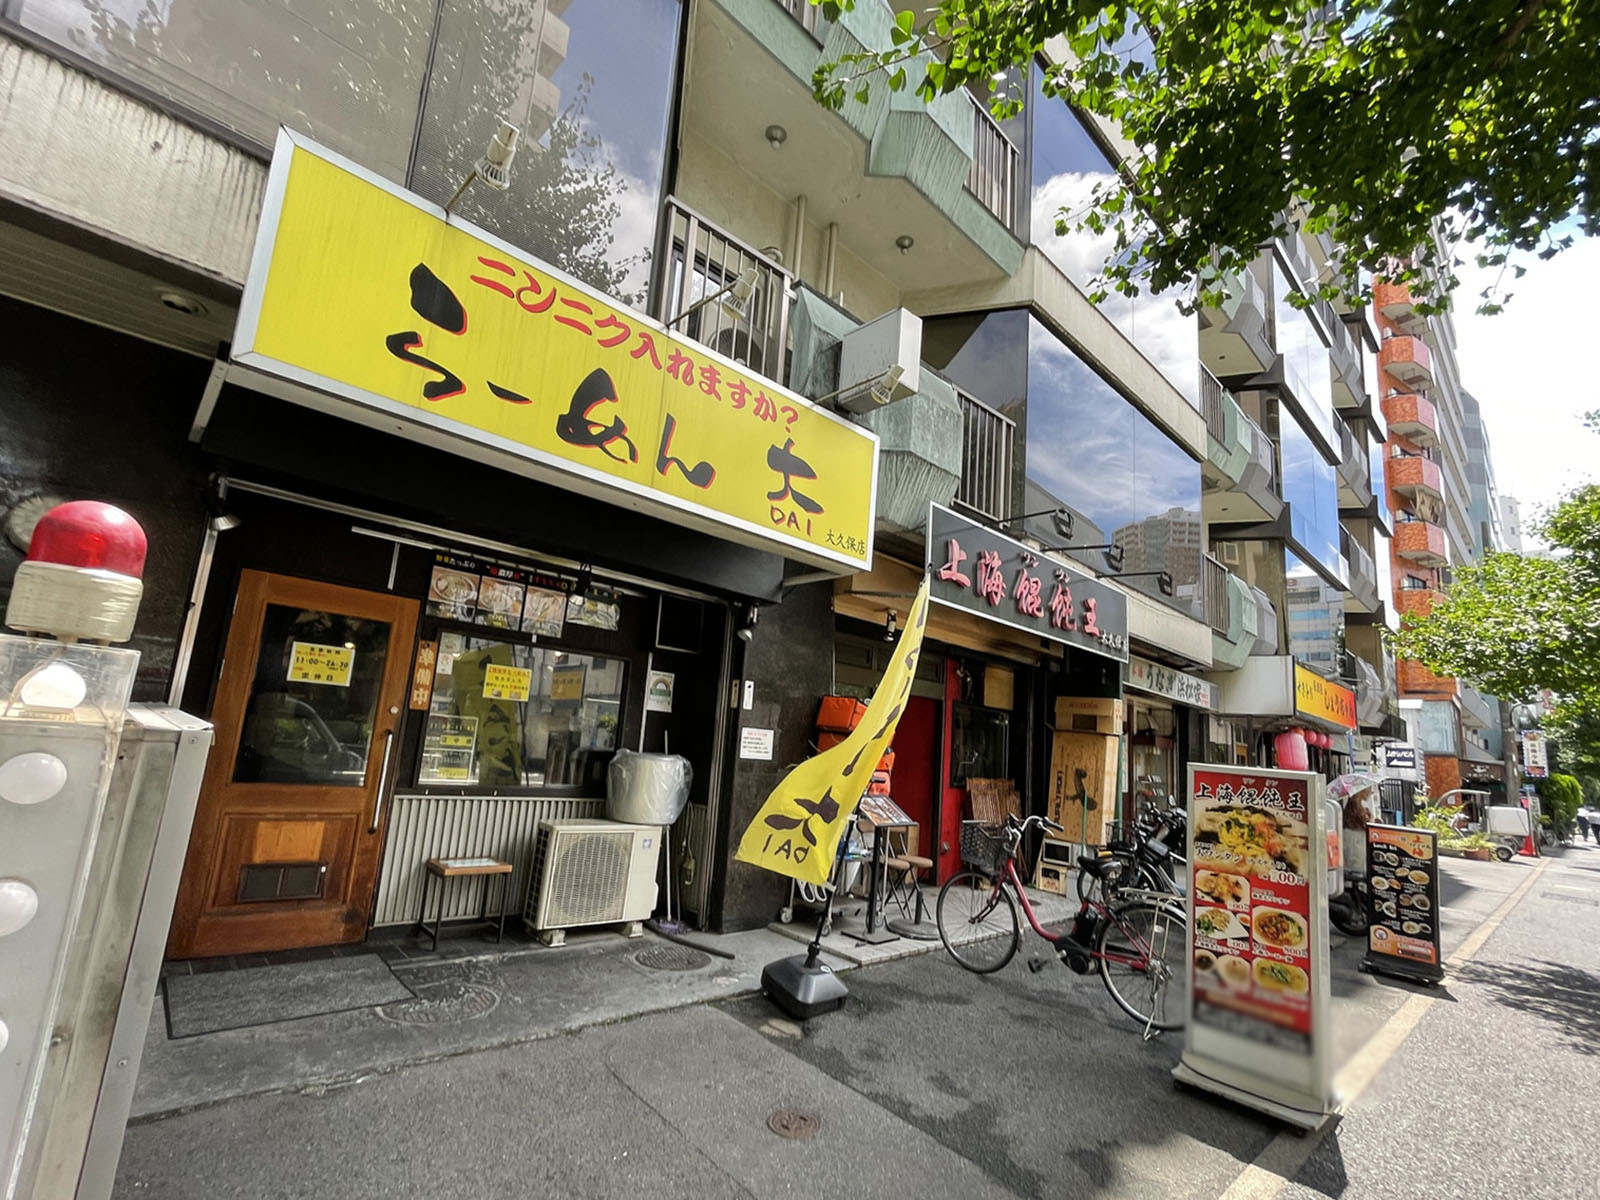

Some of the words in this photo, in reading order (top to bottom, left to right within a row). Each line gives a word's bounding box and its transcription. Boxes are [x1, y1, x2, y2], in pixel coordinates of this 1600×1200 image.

[385, 262, 716, 489] らーめん
[766, 437, 825, 515] 大
[470, 256, 799, 433] ニンニク入れますか？
[770, 505, 812, 537] DAI
[825, 528, 866, 556] 大久保店
